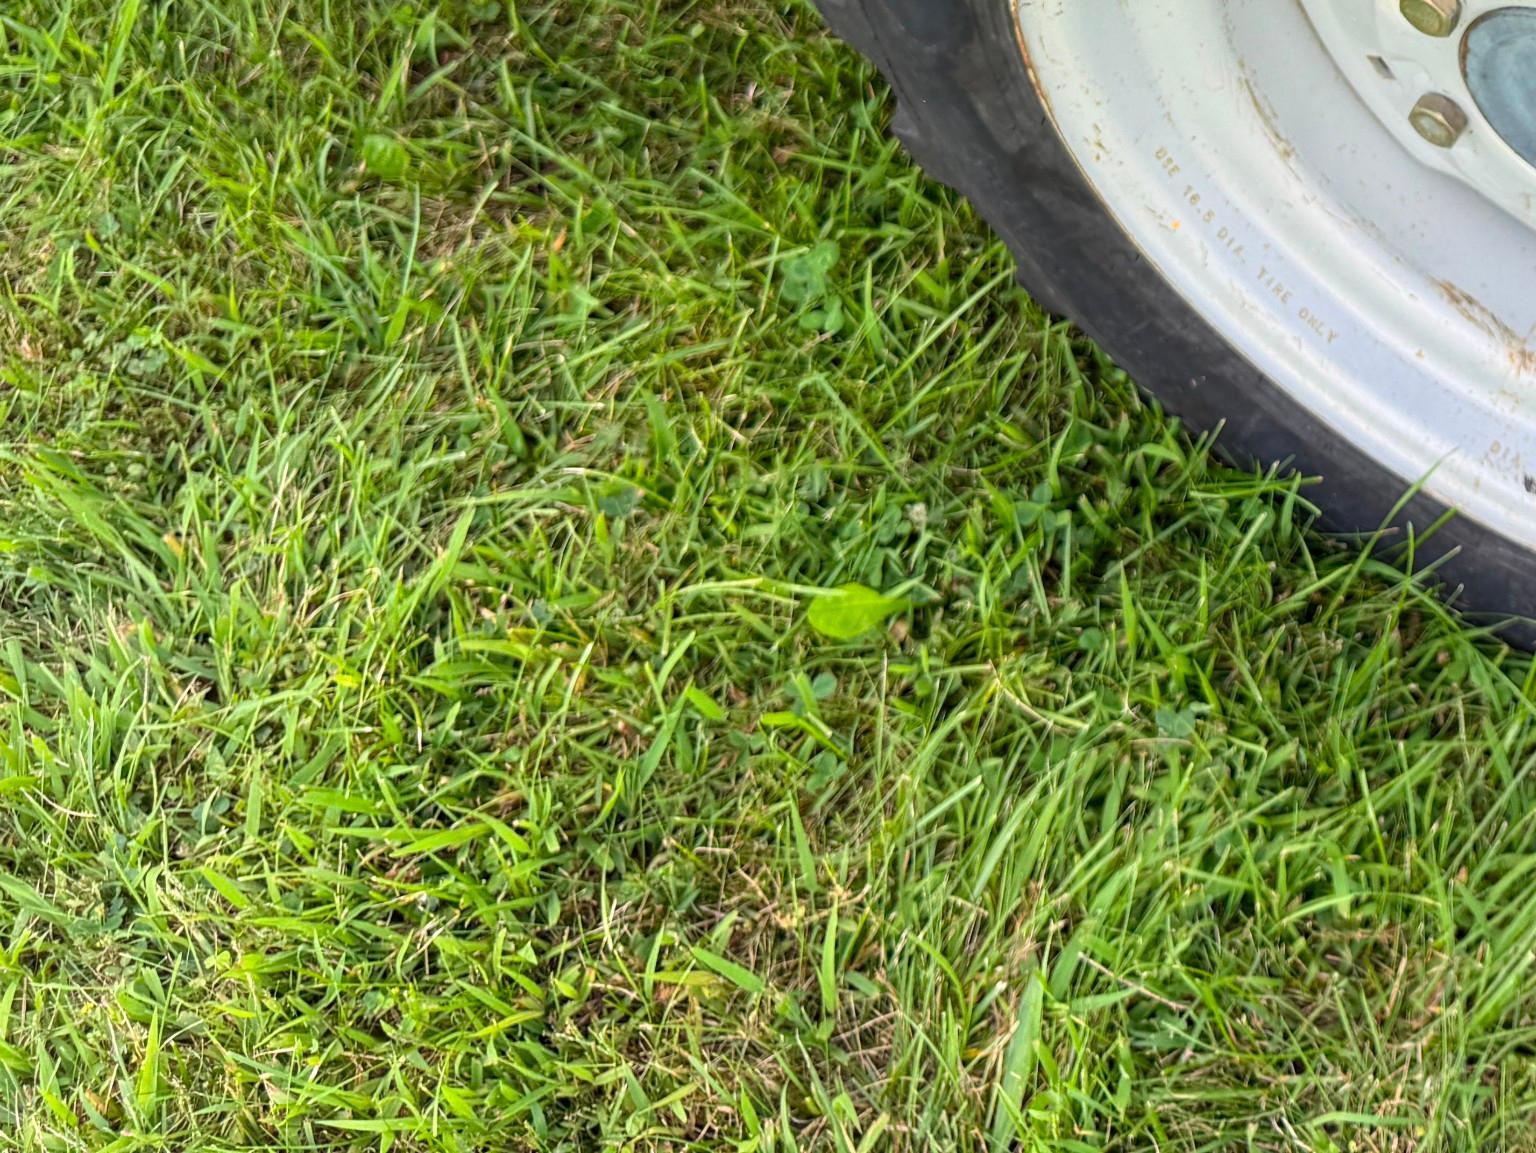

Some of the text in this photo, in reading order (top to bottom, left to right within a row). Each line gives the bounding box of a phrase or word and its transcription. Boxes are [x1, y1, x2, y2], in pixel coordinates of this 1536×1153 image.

[1154, 146, 1181, 177] USE
[1256, 266, 1293, 305] TIRE
[1298, 306, 1339, 344] ONLY
